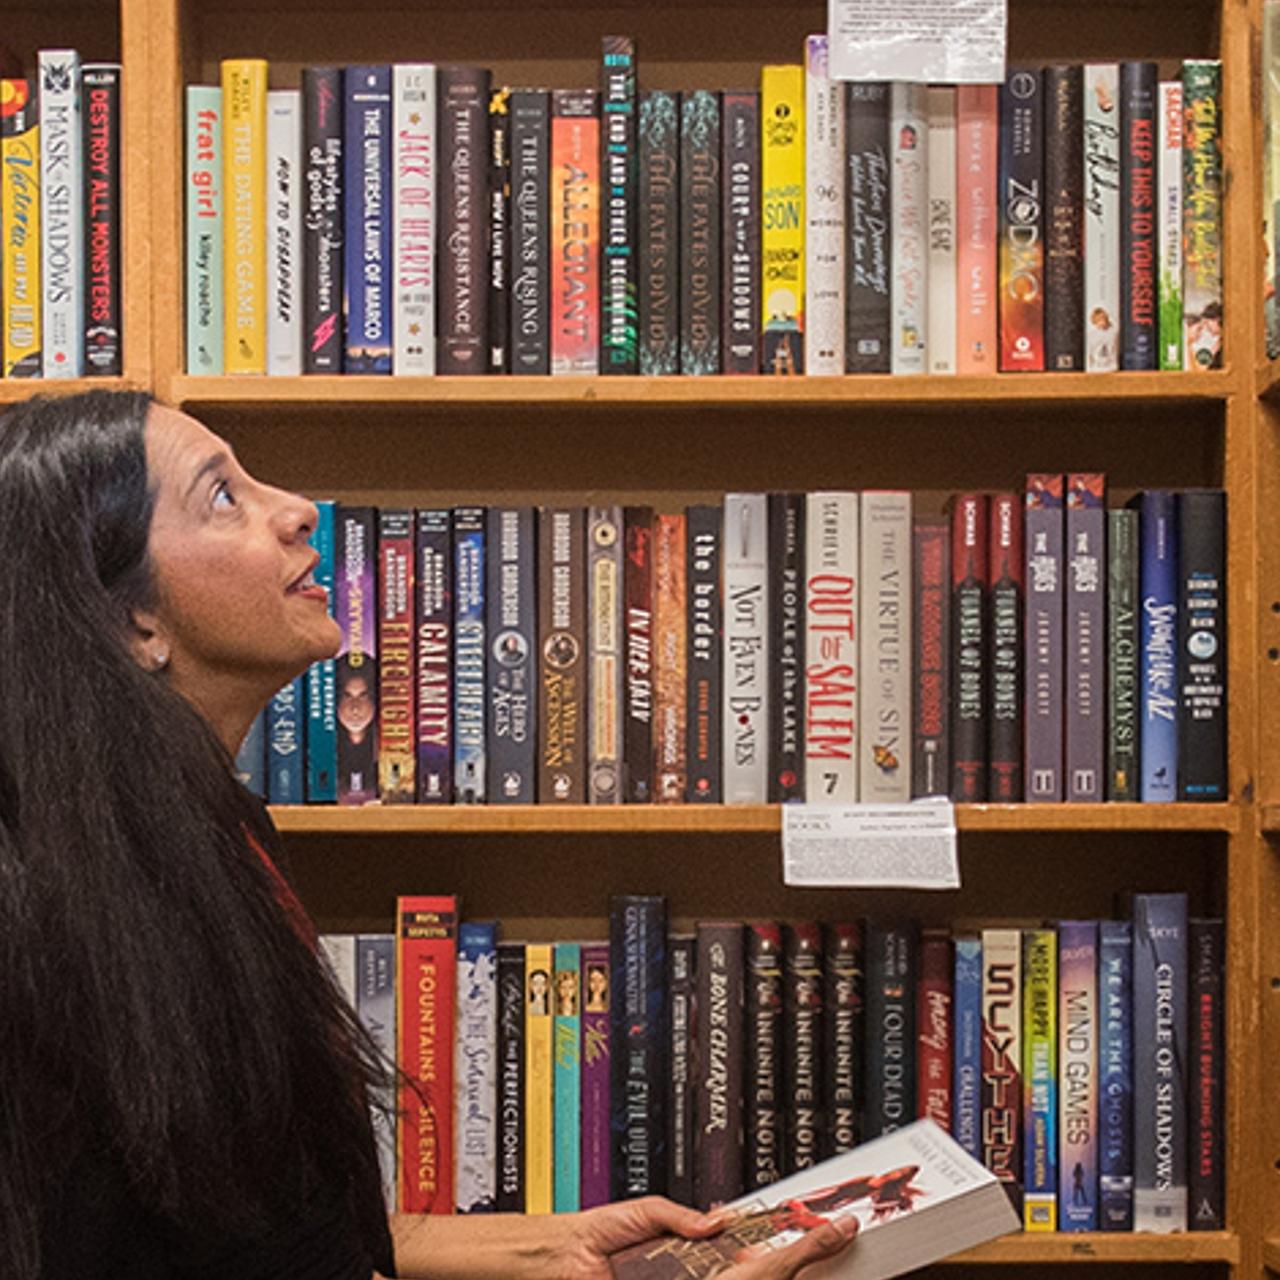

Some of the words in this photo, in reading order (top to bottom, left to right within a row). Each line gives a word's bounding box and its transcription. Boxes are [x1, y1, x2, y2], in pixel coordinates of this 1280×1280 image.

[46, 105, 69, 171] MASK
[91, 89, 109, 175] DESTROY
[365, 109, 381, 135] THE
[400, 131, 432, 179] JACK
[1131, 119, 1151, 161] KEEP
[91, 180, 109, 217] ALL
[365, 139, 381, 218] UNIVERSAL
[400, 187, 431, 209] OF
[1131, 169, 1153, 212] THIS
[47, 186, 70, 304] SHADOWS
[365, 221, 381, 261] LAWS
[765, 202, 800, 230] SON
[1008, 177, 1039, 302] ZODIAC
[1131, 217, 1152, 237] TO
[91, 222, 110, 320] MONSTERS
[365, 263, 381, 282] OF
[400, 218, 431, 287] HEARTS
[563, 165, 588, 341] ALLEGIANT
[1132, 241, 1153, 326] YOURSELF
[365, 286, 381, 339] MARCO
[695, 534, 714, 570] the
[694, 584, 714, 660] border
[808, 575, 854, 640] OUT
[821, 638, 842, 661] OF
[1116, 609, 1134, 756] ALCHEMYST
[420, 623, 447, 746] CALAMITY
[806, 664, 855, 760] SALEM
[420, 964, 436, 1083] FOUNTAINS
[711, 972, 727, 1019] BONE
[1065, 992, 1087, 1056] MIND
[1156, 963, 1172, 1045] CIRCLE
[705, 1024, 727, 1133] CHARMER
[983, 965, 1017, 1182] SCYTHE
[1156, 1049, 1172, 1078] OF
[1066, 1061, 1089, 1145] GAMES
[1156, 1082, 1172, 1192] SHADOWS
[420, 1106, 436, 1192] SILENCE
